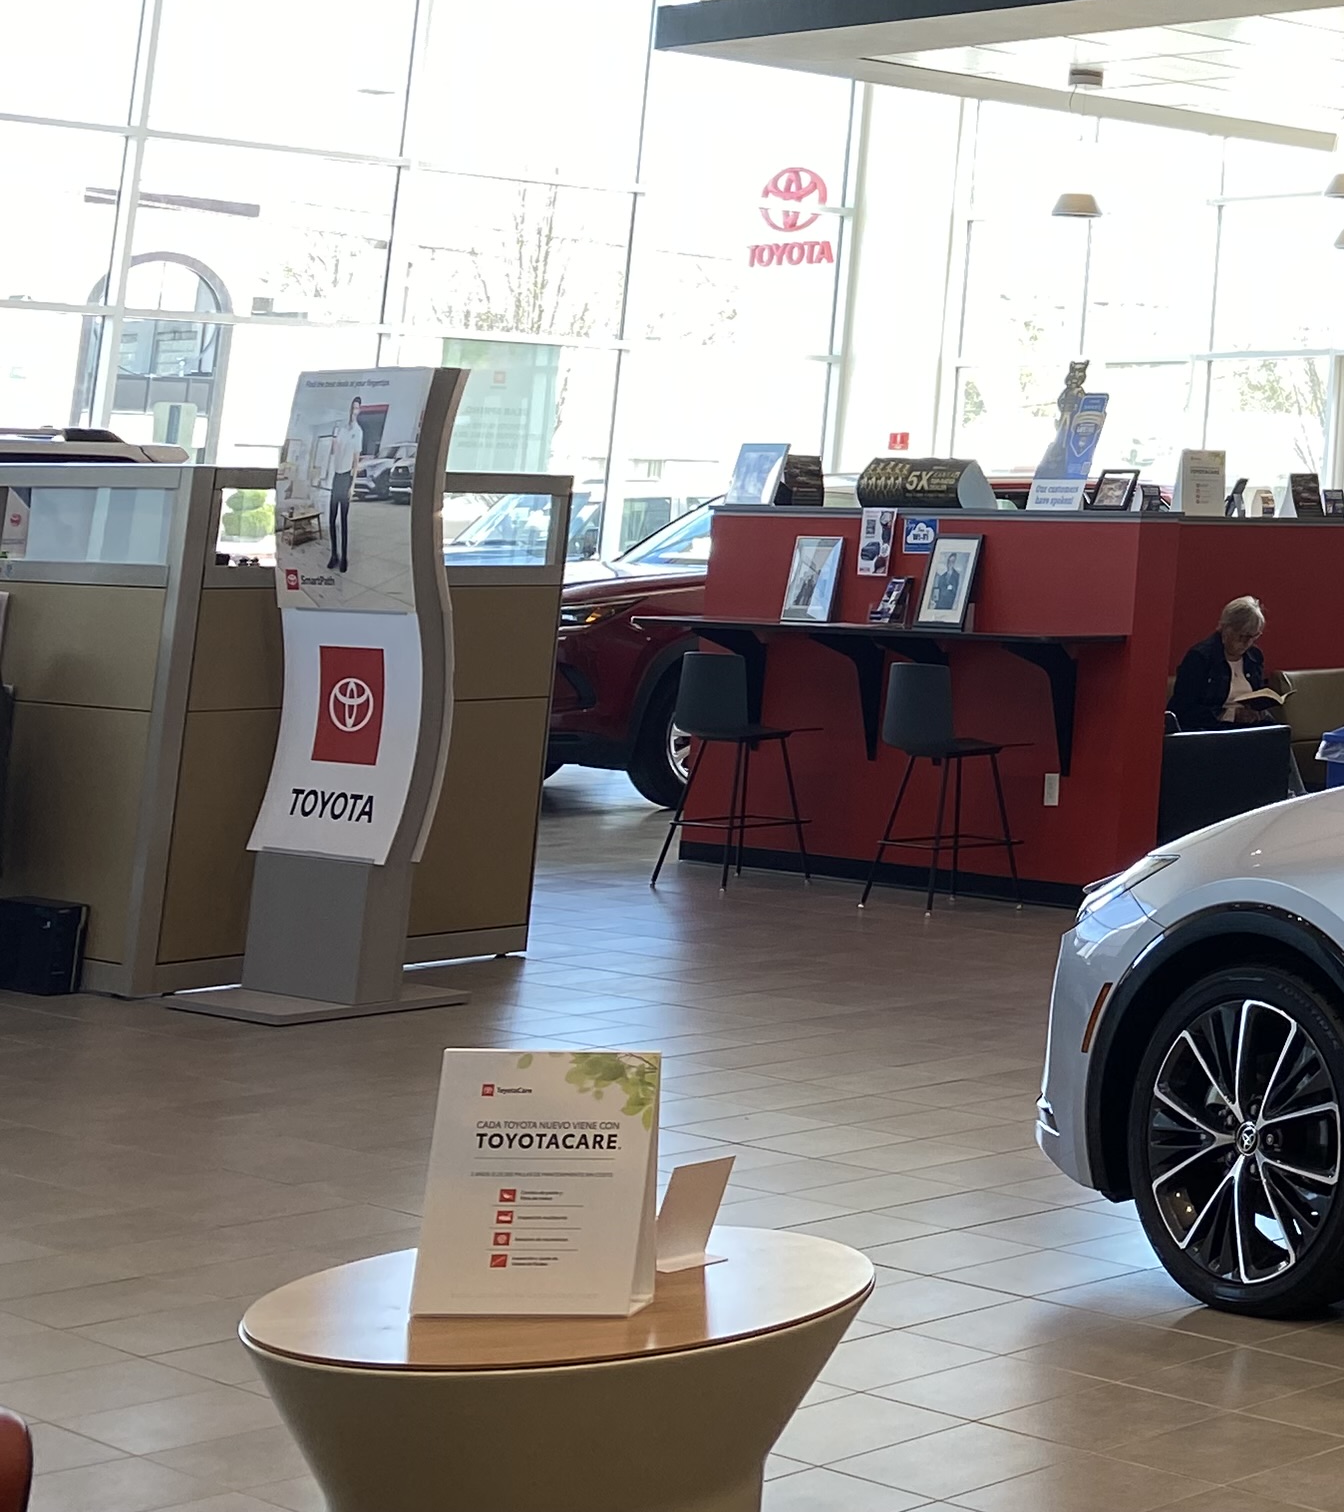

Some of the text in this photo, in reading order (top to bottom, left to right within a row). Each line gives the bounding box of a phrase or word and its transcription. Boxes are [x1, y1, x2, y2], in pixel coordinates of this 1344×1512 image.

[747, 240, 834, 267] TOYOTA
[289, 788, 375, 824] TOYOTA
[497, 1087, 533, 1095] ToyotaCare
[476, 1121, 621, 1130] CADA TOYOTA NUEVO VIENE CON
